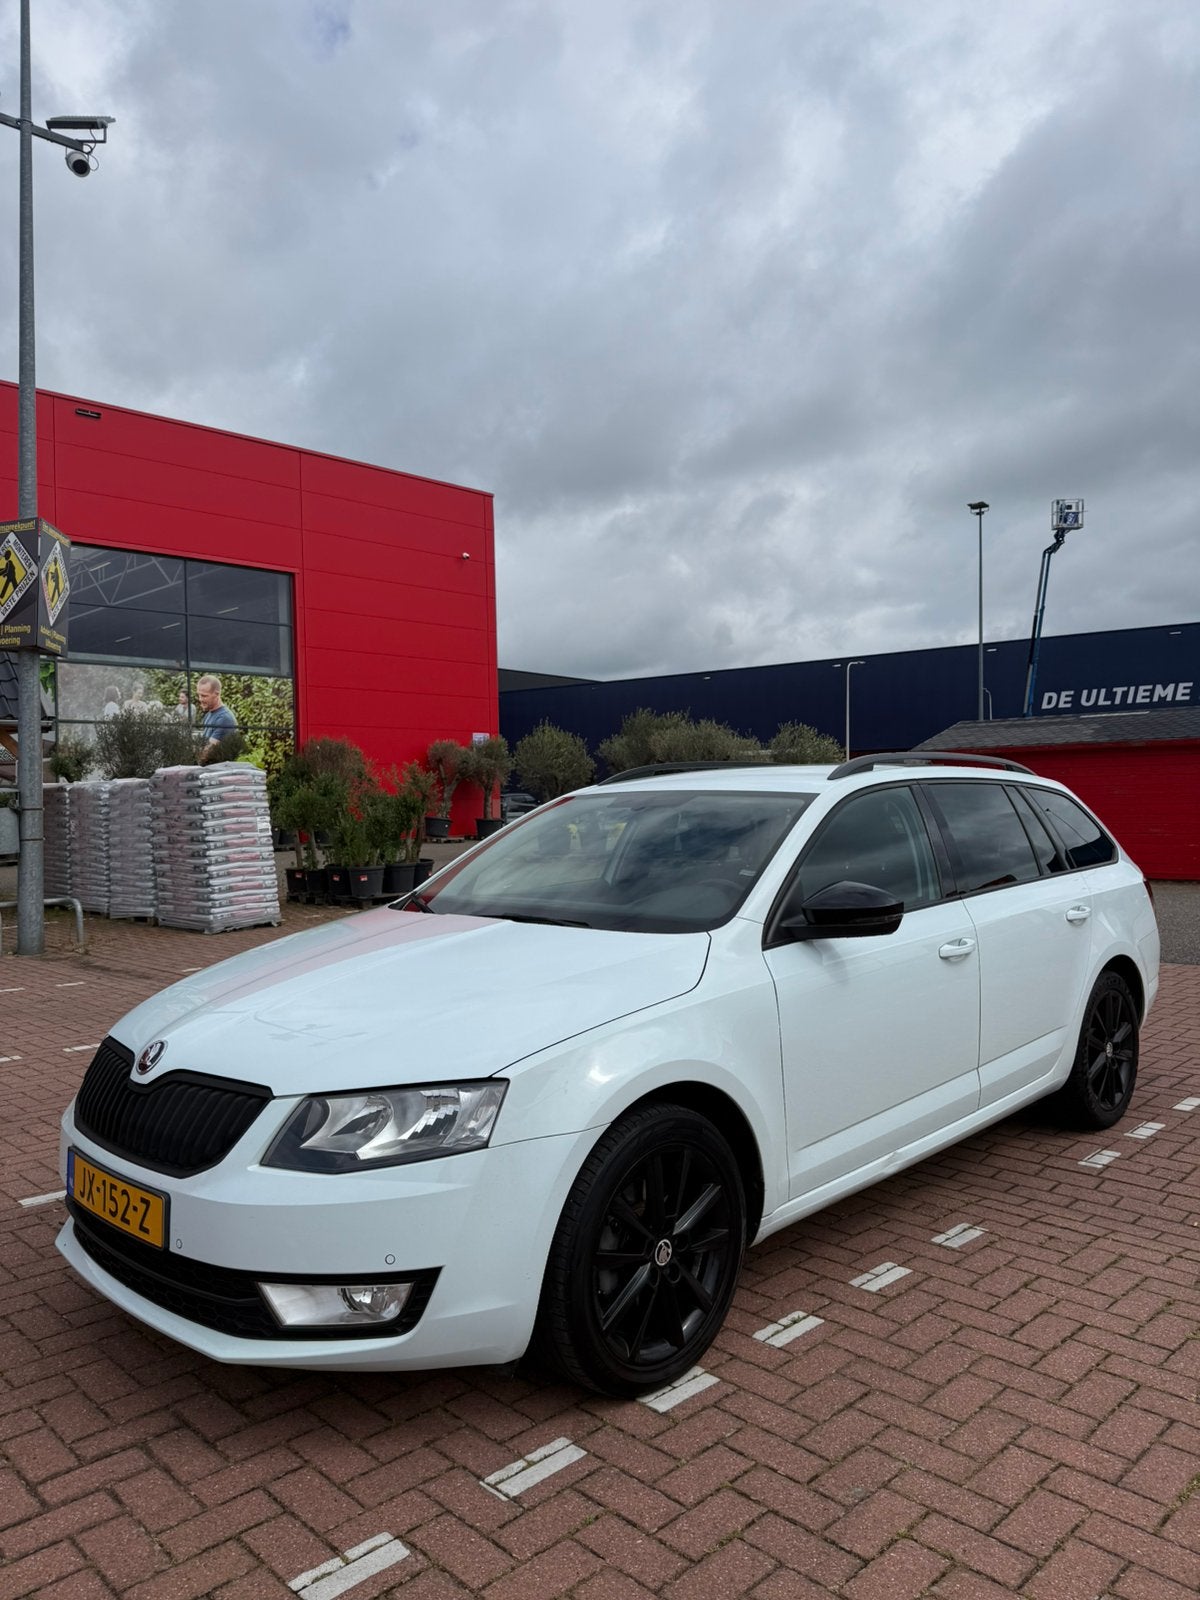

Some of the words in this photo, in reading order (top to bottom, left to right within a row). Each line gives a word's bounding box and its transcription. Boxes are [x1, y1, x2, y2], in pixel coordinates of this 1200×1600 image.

[13, 539, 34, 569] MONTEREN
[1, 596, 16, 616] VASTE
[4, 624, 31, 634] Planning
[1041, 690, 1074, 710] DE
[1080, 682, 1194, 707] ULTIEME
[79, 1167, 151, 1235] JX-152-Z
